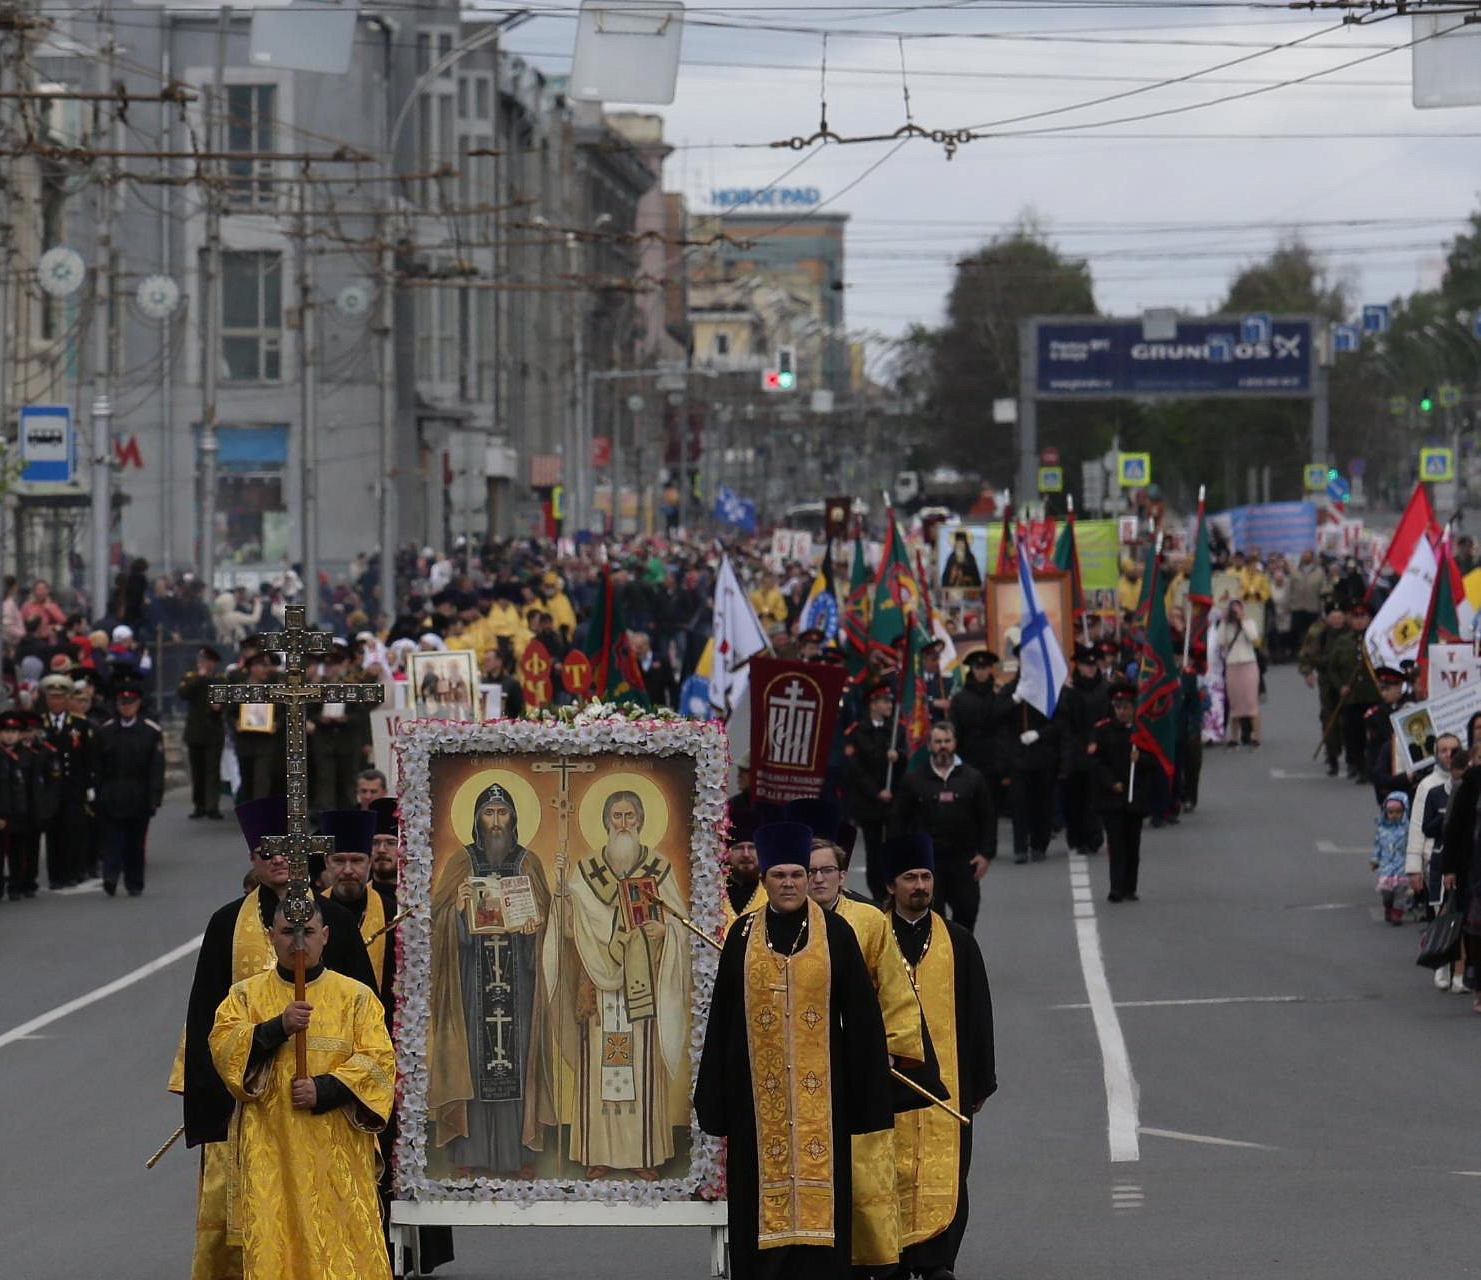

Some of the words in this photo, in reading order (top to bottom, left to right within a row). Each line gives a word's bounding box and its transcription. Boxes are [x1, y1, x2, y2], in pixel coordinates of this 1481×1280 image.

[1130, 342, 1271, 361] GRUNOS
[525, 652, 547, 675] Ф
[565, 664, 587, 688] Т
